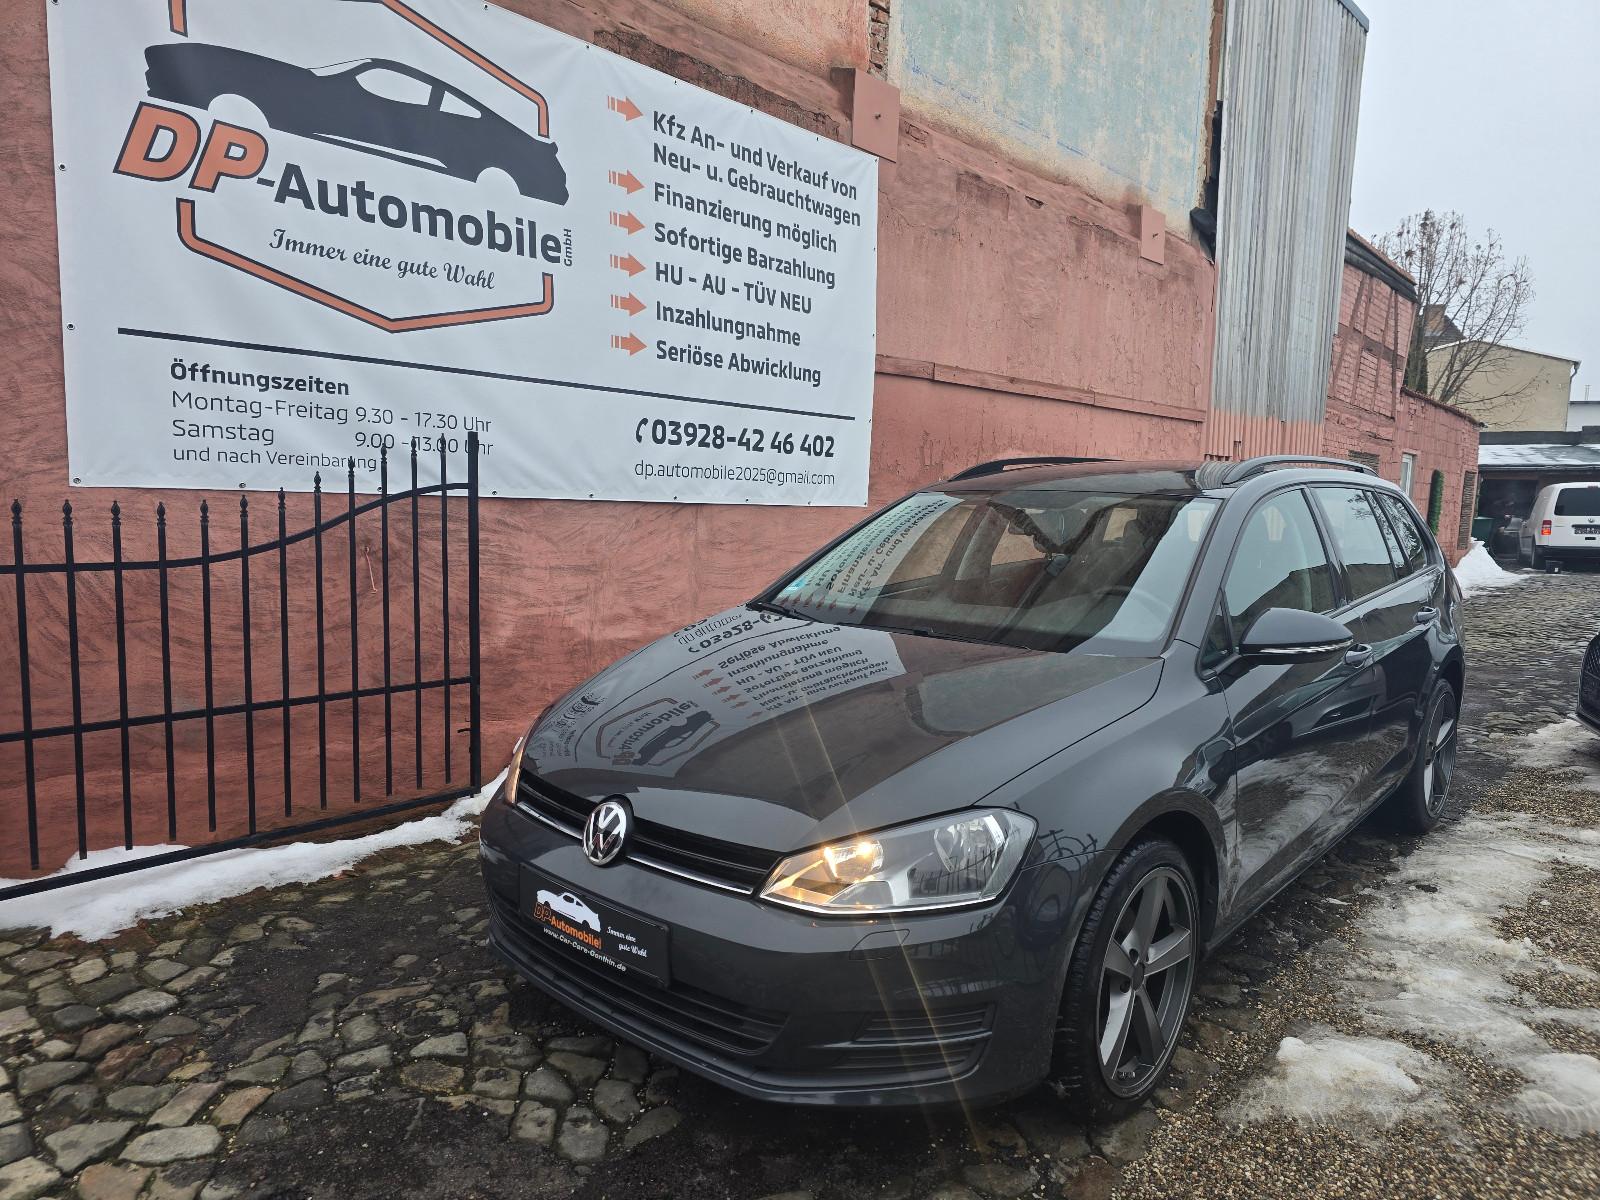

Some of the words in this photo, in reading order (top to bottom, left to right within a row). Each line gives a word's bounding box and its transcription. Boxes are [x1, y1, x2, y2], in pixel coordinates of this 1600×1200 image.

[653, 111, 686, 140] Kfz
[690, 126, 725, 152] An-
[730, 142, 763, 168] und
[766, 151, 829, 190] Verkauf
[831, 178, 858, 201] von
[653, 143, 701, 174] Neu-
[706, 163, 724, 183] u.
[727, 168, 861, 227] Gebrauchtwagen
[654, 182, 773, 238] Finanzierung
[776, 222, 838, 253] möglich
[269, 228, 347, 262] Immer
[353, 248, 392, 271] eine
[397, 260, 438, 280] gute
[443, 263, 496, 290] Wahl
[563, 228, 574, 267] GmbH
[654, 223, 743, 264] Sofortige
[747, 247, 836, 290] Barzahlung
[655, 262, 683, 286] HU
[702, 274, 726, 296] AU
[743, 281, 777, 307] TÜV
[780, 292, 812, 314] NEU
[656, 301, 801, 346] Inzahlungnahme
[170, 358, 350, 396] Öffnungszeiten
[656, 340, 724, 369] Seriöse
[728, 353, 822, 388] Abwicklung
[172, 390, 349, 424] Montag-Freitag
[355, 407, 394, 425] 9.30
[414, 412, 458, 430] 17.30
[463, 416, 493, 433] Uhr
[172, 420, 275, 446] Samstag
[354, 432, 395, 450] 9.00
[173, 447, 211, 462] und
[217, 449, 262, 465] nach
[651, 419, 765, 453] 03928-42
[770, 432, 795, 454] 46
[800, 434, 835, 458] 402
[634, 460, 836, 487] dp.automobile2025@gmail.com
